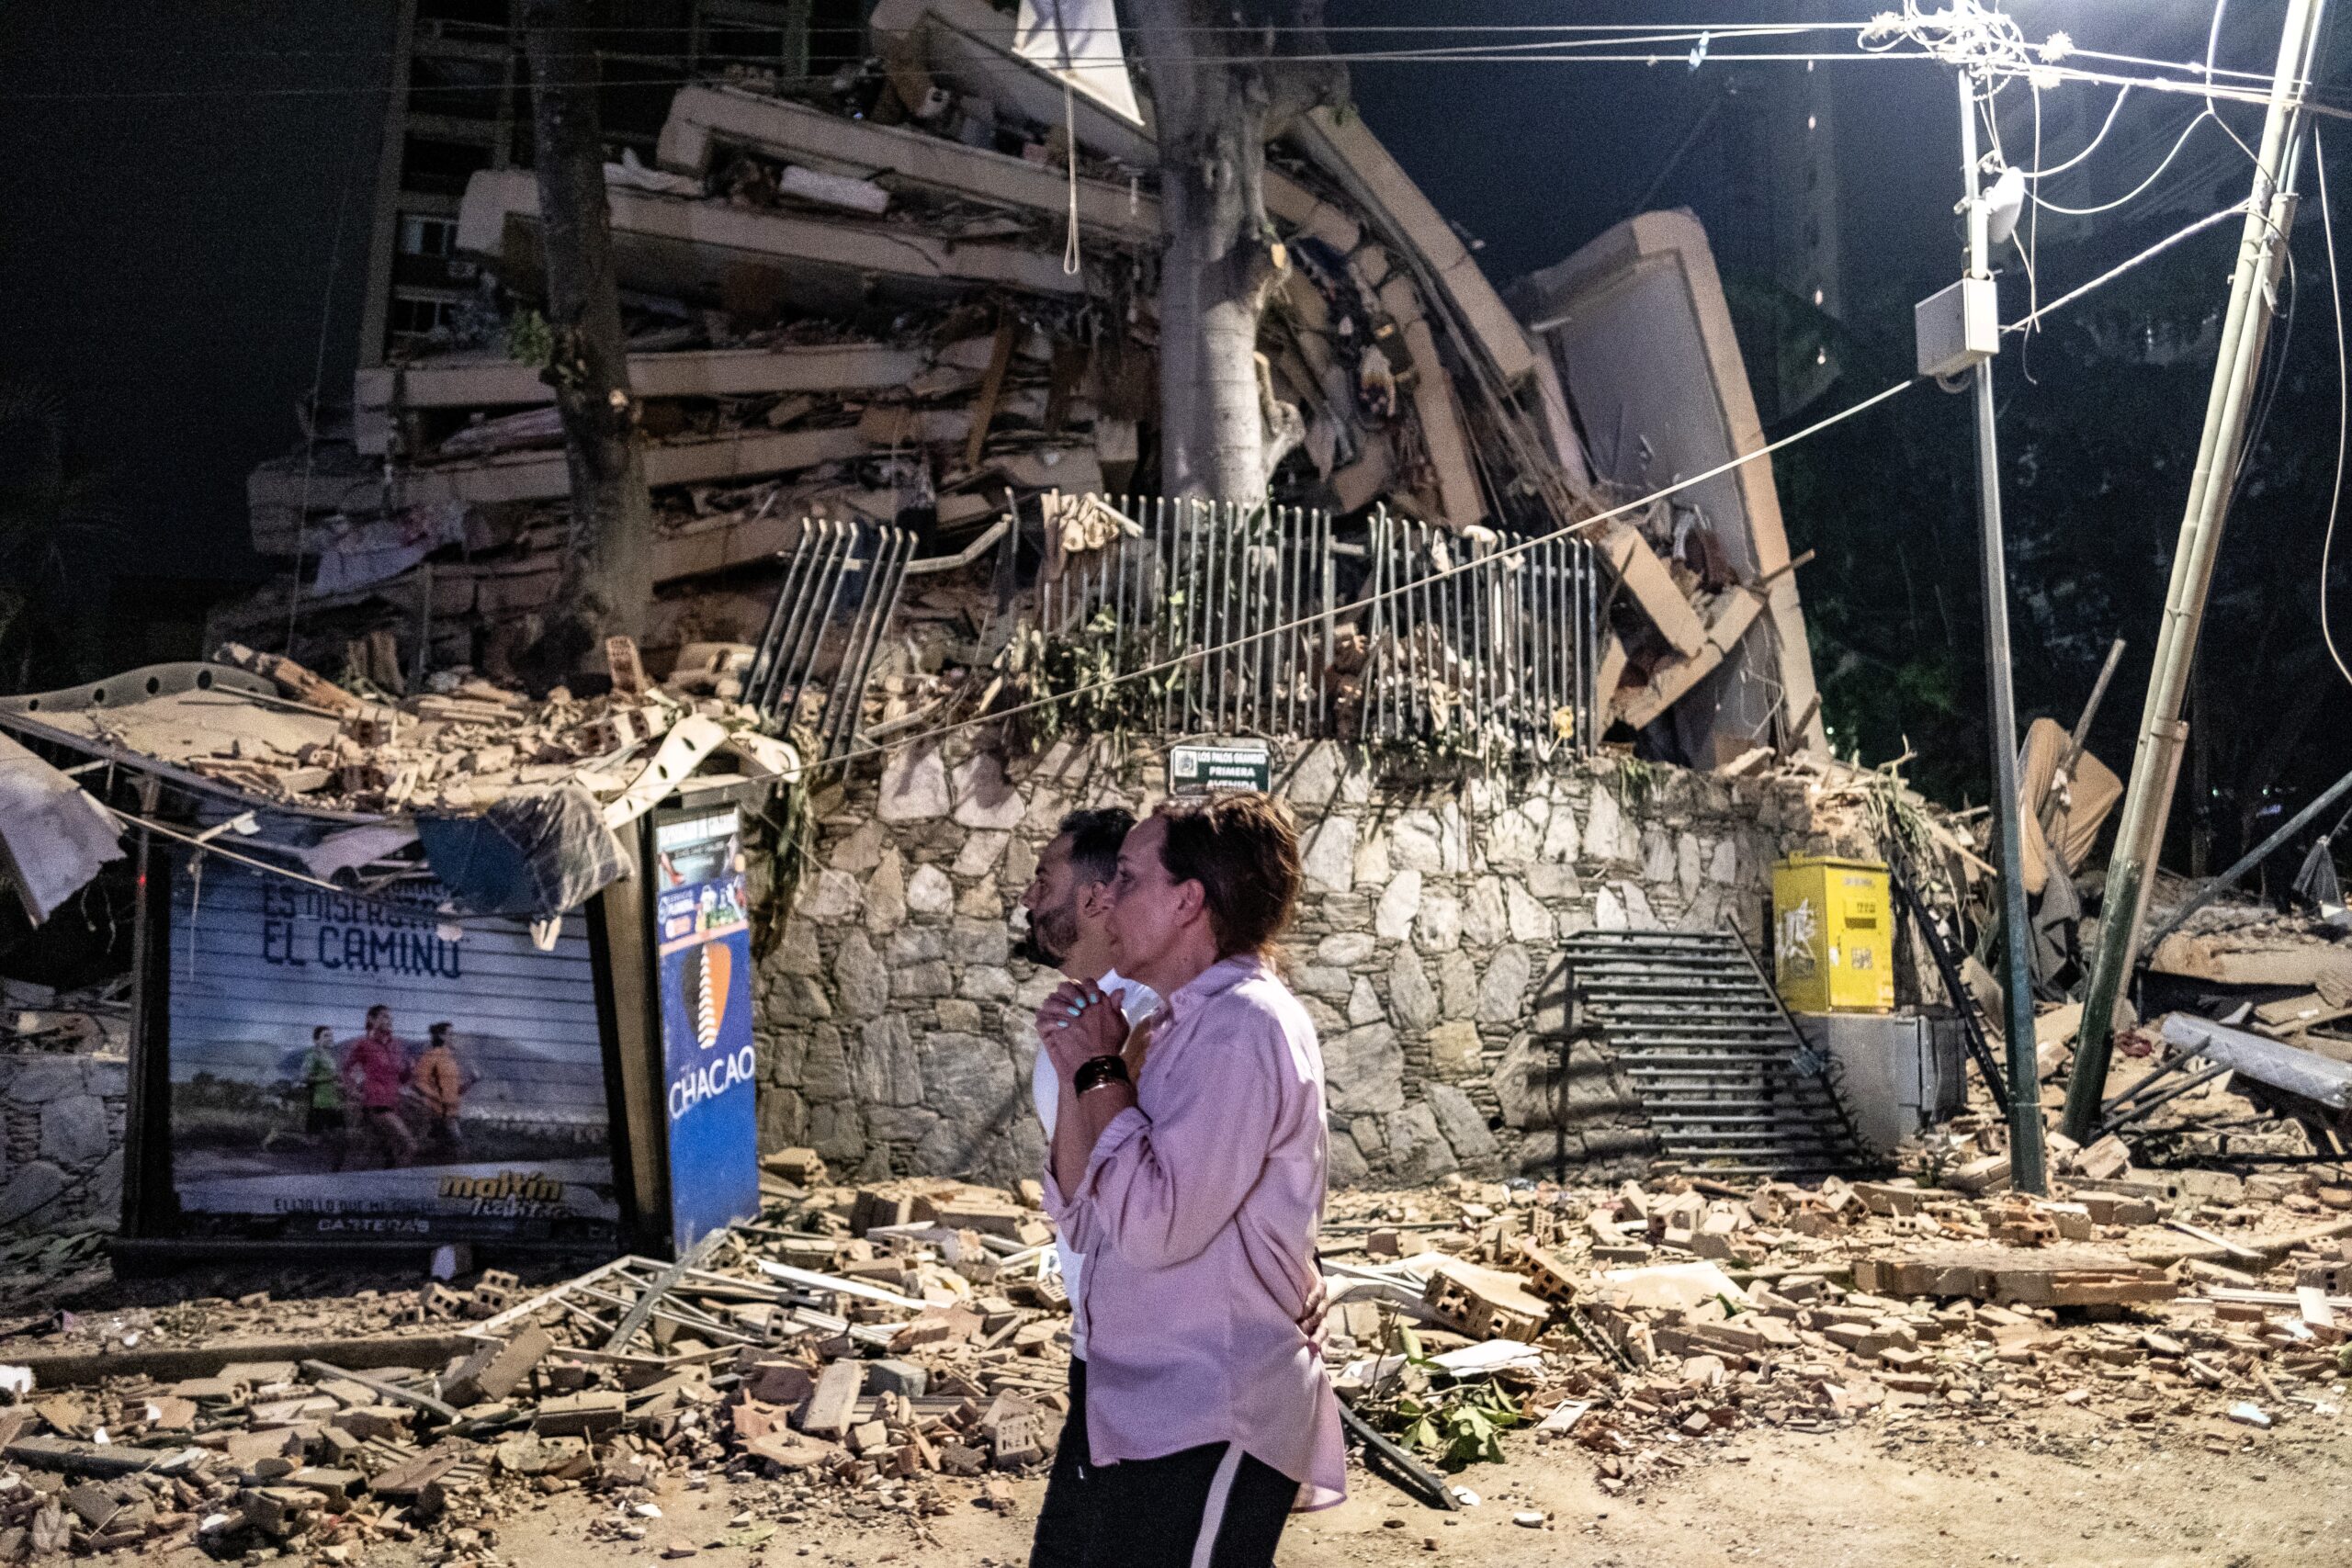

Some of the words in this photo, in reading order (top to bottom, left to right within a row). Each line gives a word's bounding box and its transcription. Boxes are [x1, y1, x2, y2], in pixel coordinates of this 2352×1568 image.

[1197, 751, 1211, 762] LOS
[1209, 766, 1256, 777] PRIMERA
[263, 919, 307, 966] EL
[318, 924, 461, 979] CAMINO
[668, 1044, 756, 1120] CHACAO
[439, 1170, 565, 1202] maltín
